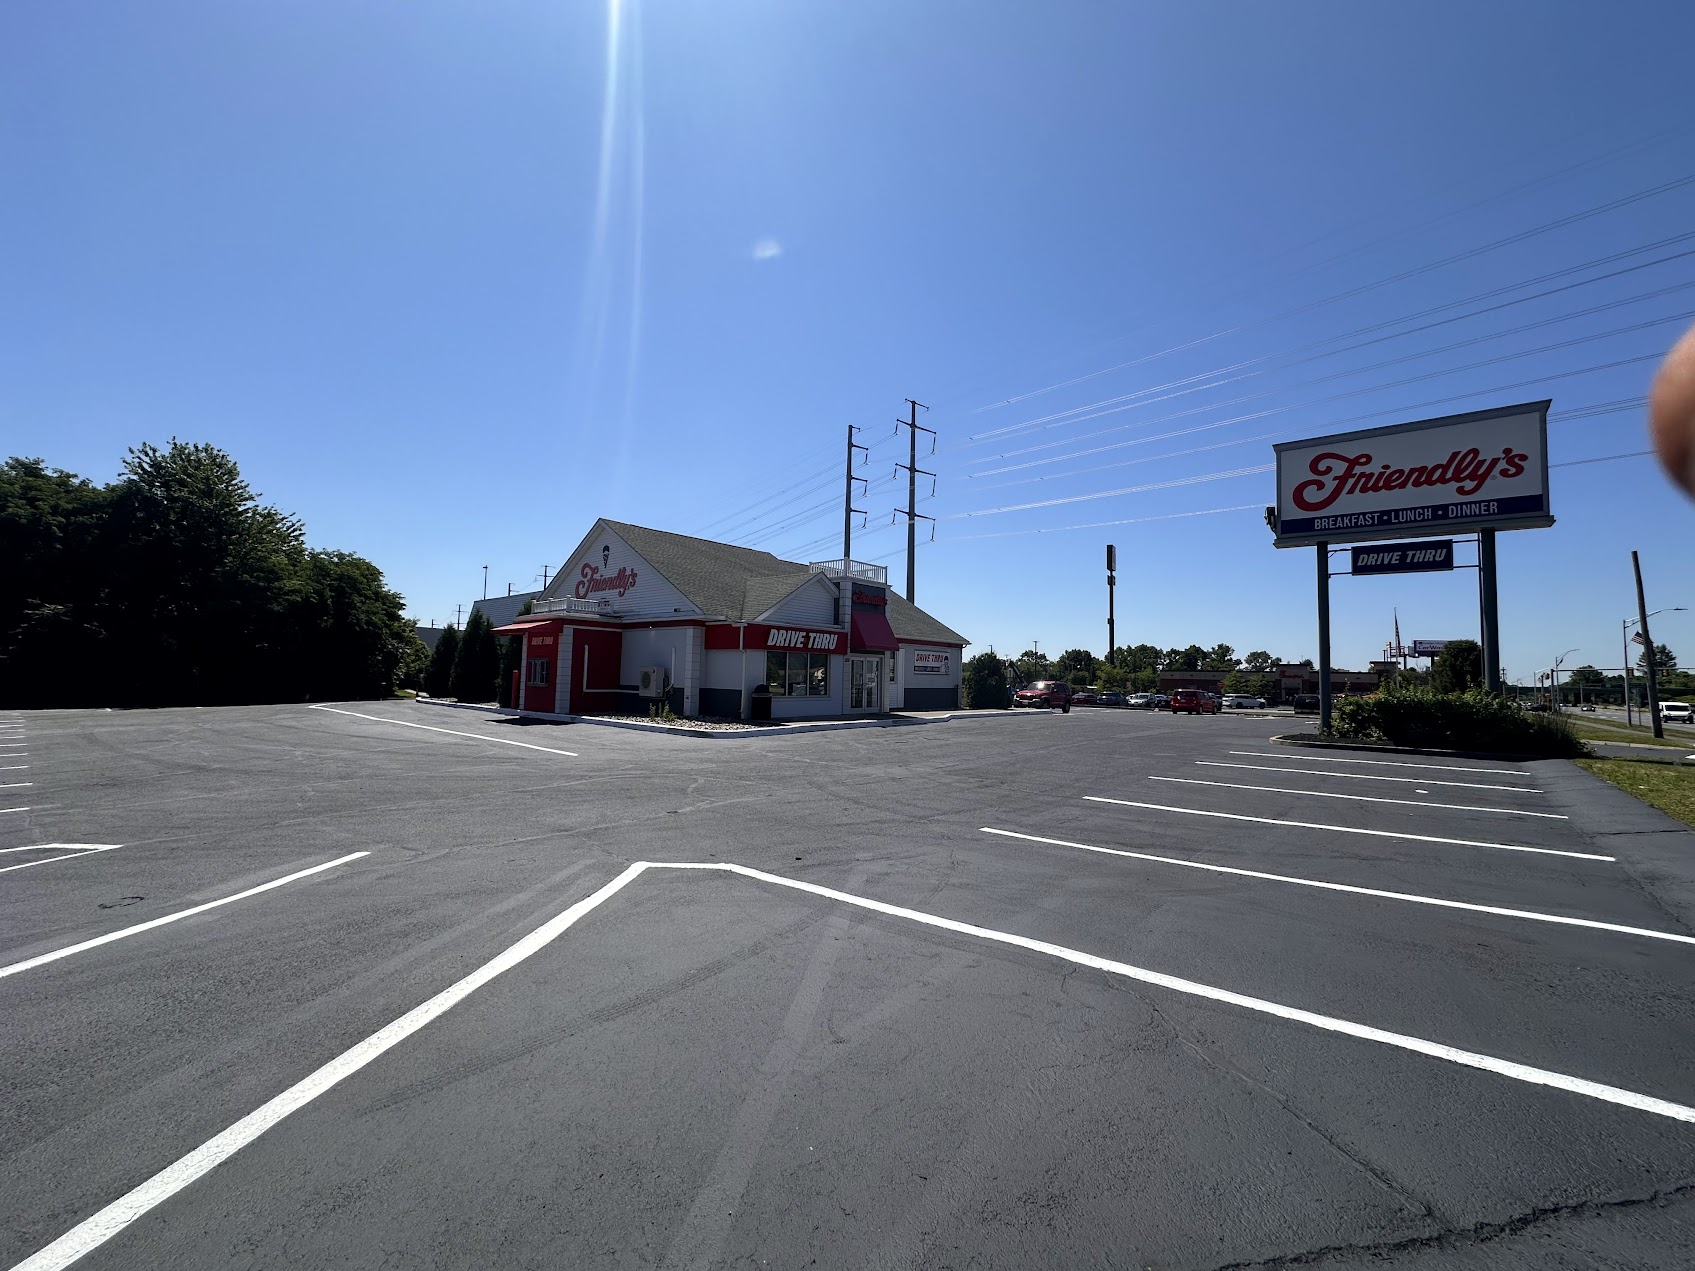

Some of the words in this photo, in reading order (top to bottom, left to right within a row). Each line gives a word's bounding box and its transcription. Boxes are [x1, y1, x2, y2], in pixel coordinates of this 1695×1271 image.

[1292, 447, 1529, 512] Friendly's
[1314, 513, 1380, 530] BREAKFAST
[1391, 507, 1432, 523] LUNCH
[1448, 502, 1498, 518] DINNER
[1357, 552, 1401, 567] DRIVE
[1406, 548, 1447, 563] THRU
[575, 562, 638, 599] Friendly's
[767, 628, 806, 648] DRIVE
[807, 631, 839, 650] THRU
